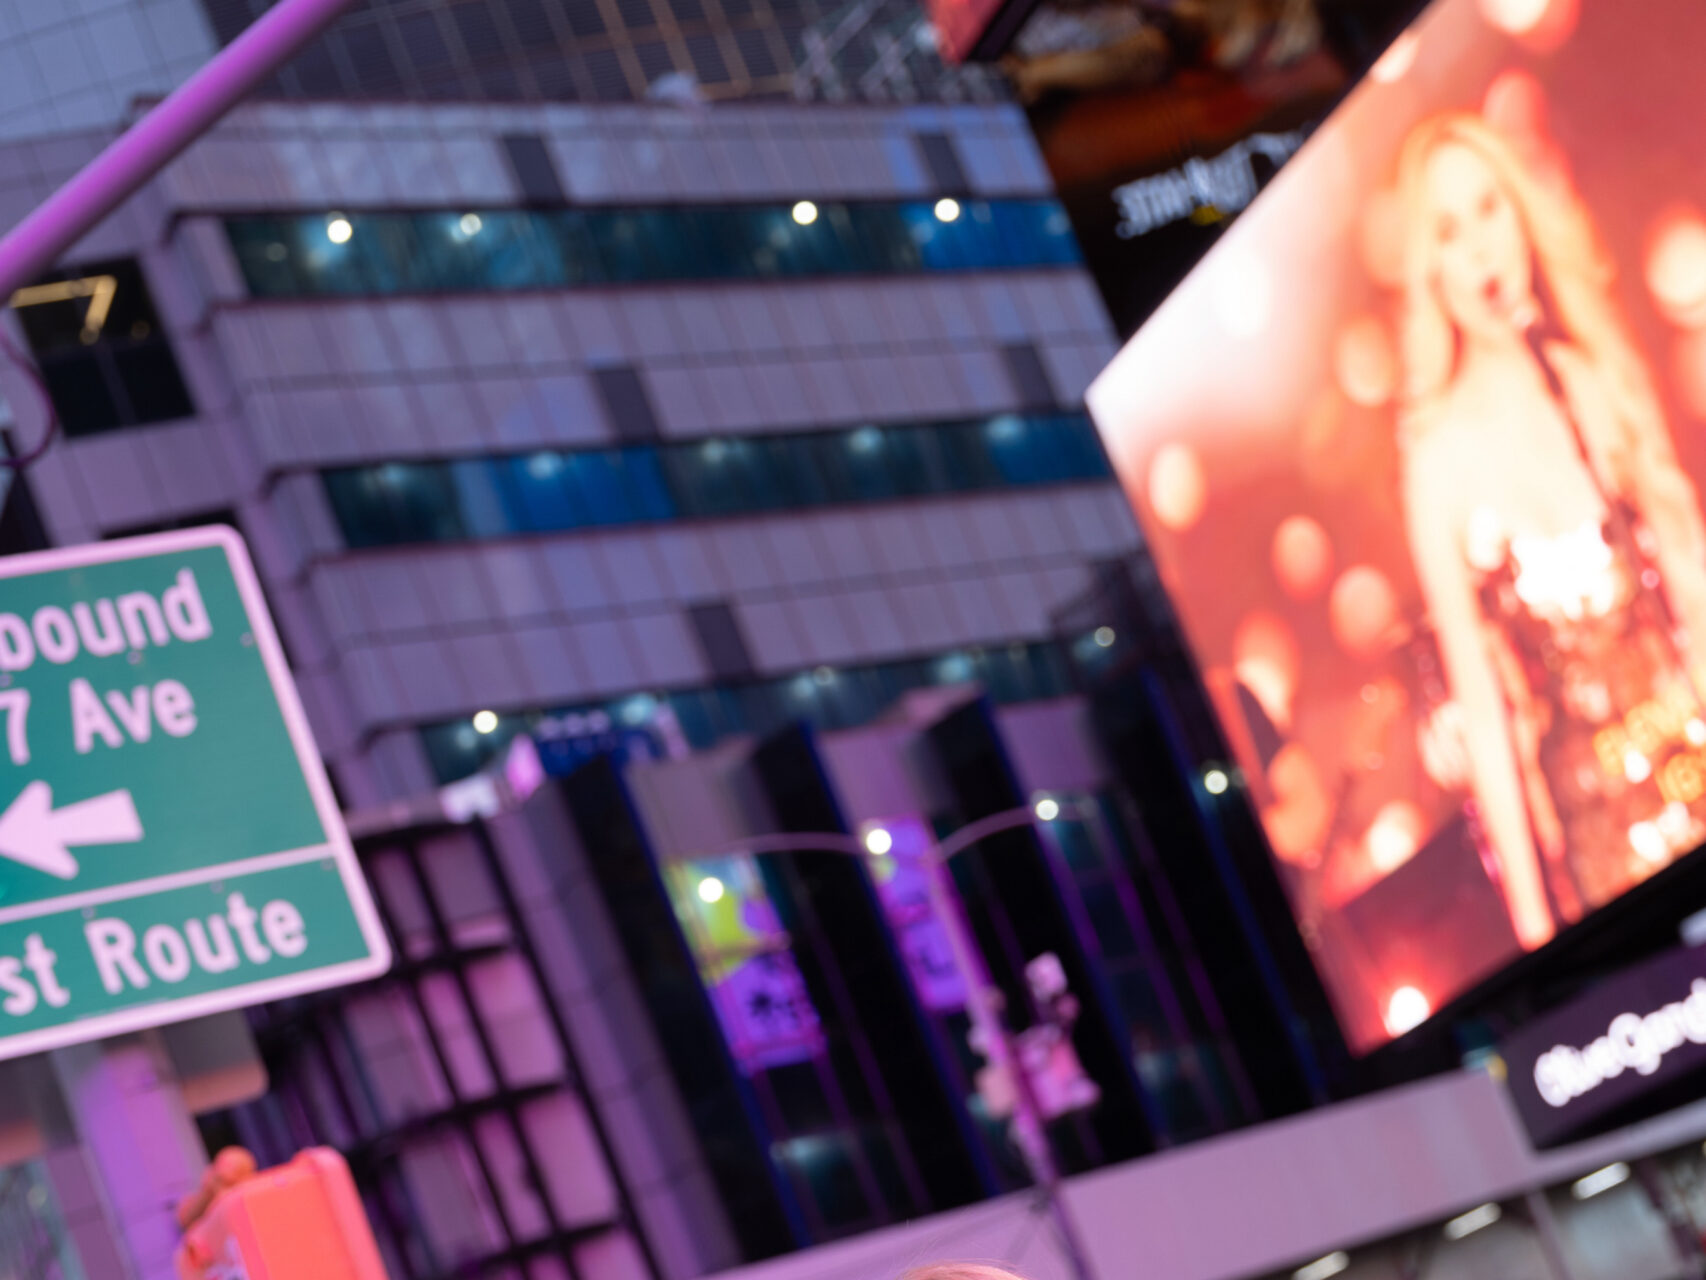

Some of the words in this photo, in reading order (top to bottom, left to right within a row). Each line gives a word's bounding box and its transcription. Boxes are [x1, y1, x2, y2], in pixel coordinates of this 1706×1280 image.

[69, 678, 198, 754] Ave
[0, 932, 71, 1016] st
[84, 892, 308, 995] Route
